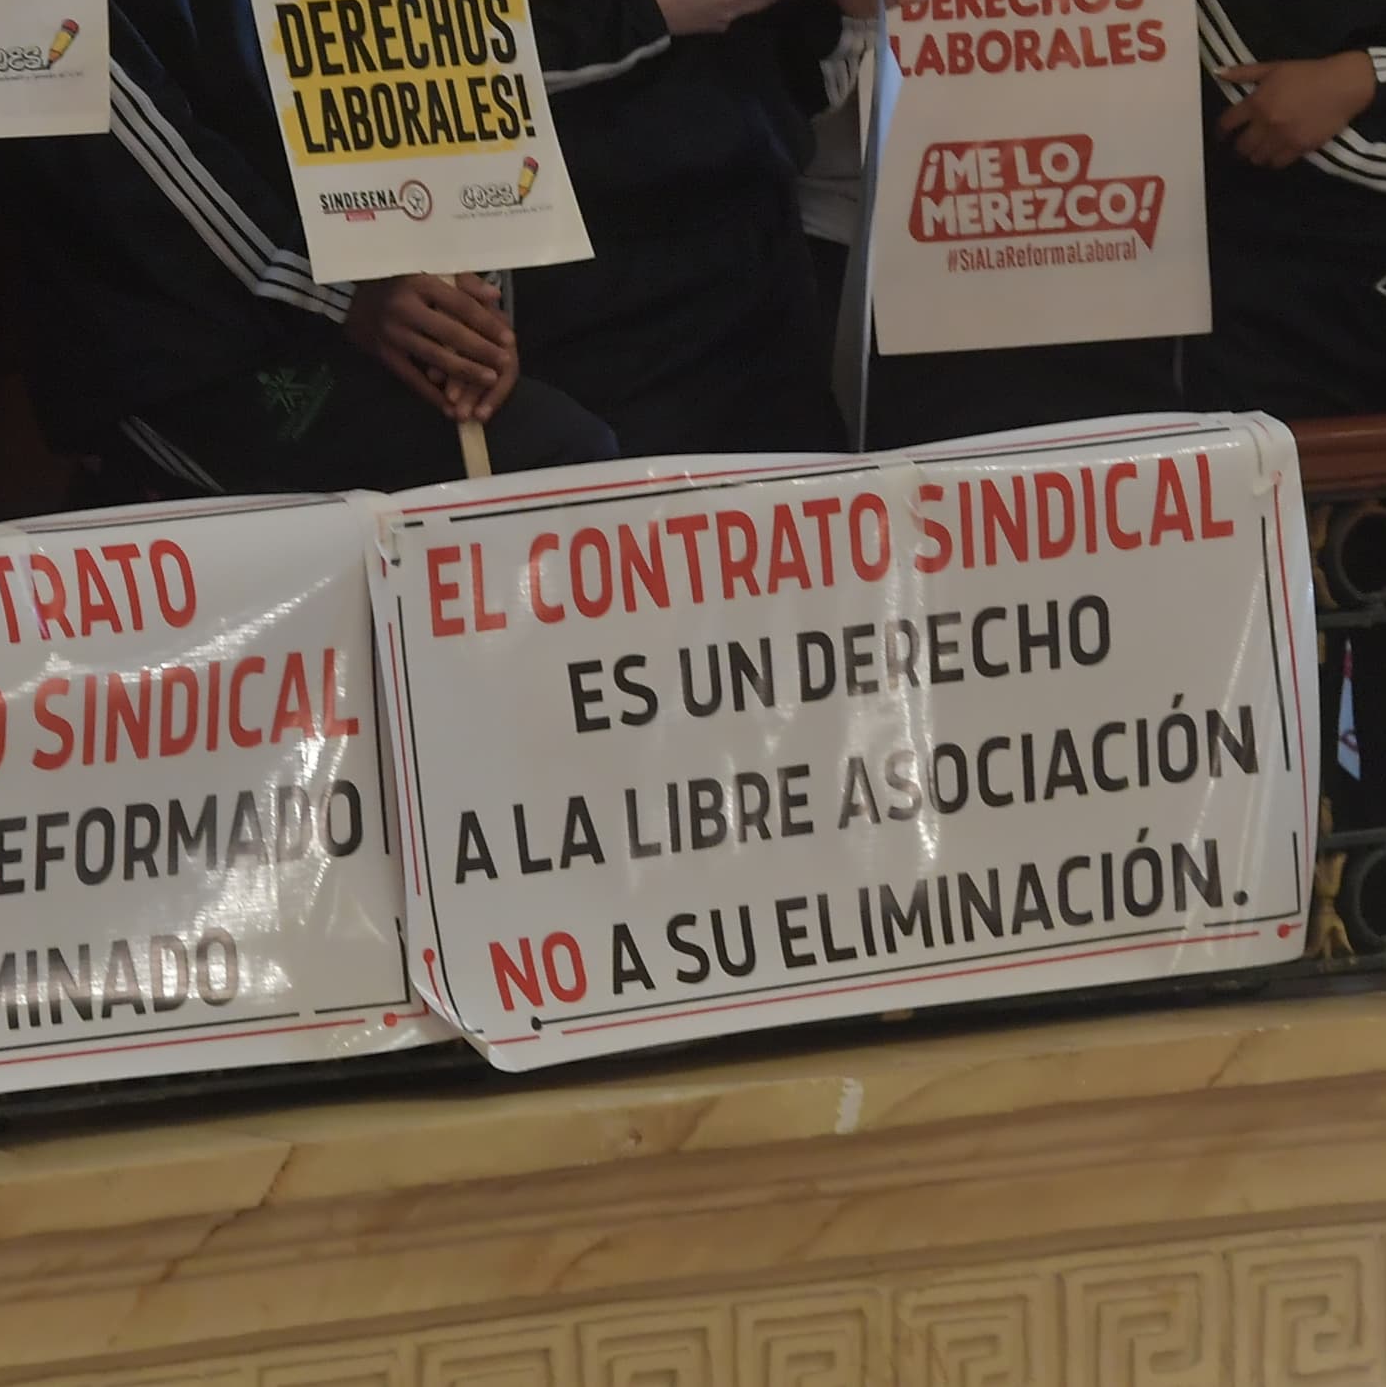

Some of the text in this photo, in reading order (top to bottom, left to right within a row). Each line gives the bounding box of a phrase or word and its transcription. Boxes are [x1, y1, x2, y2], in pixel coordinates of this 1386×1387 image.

[889, 19, 1166, 77] LABORALES
[293, 74, 536, 155] LABORALES!
[319, 190, 397, 211] SINDESENA
[919, 182, 1157, 239] MEREZCO!
[922, 142, 1080, 193] ¡ME LO
[425, 454, 1235, 638] EL CONTRATO SINDICAL
[32, 647, 360, 771] SINDICAL
[567, 594, 1112, 734] ES UN DERECHO
[454, 693, 1260, 886] A LA LIBRE ASOCIACIÓN
[488, 828, 1249, 1012] NO A SU ELIMINACIÓN.
